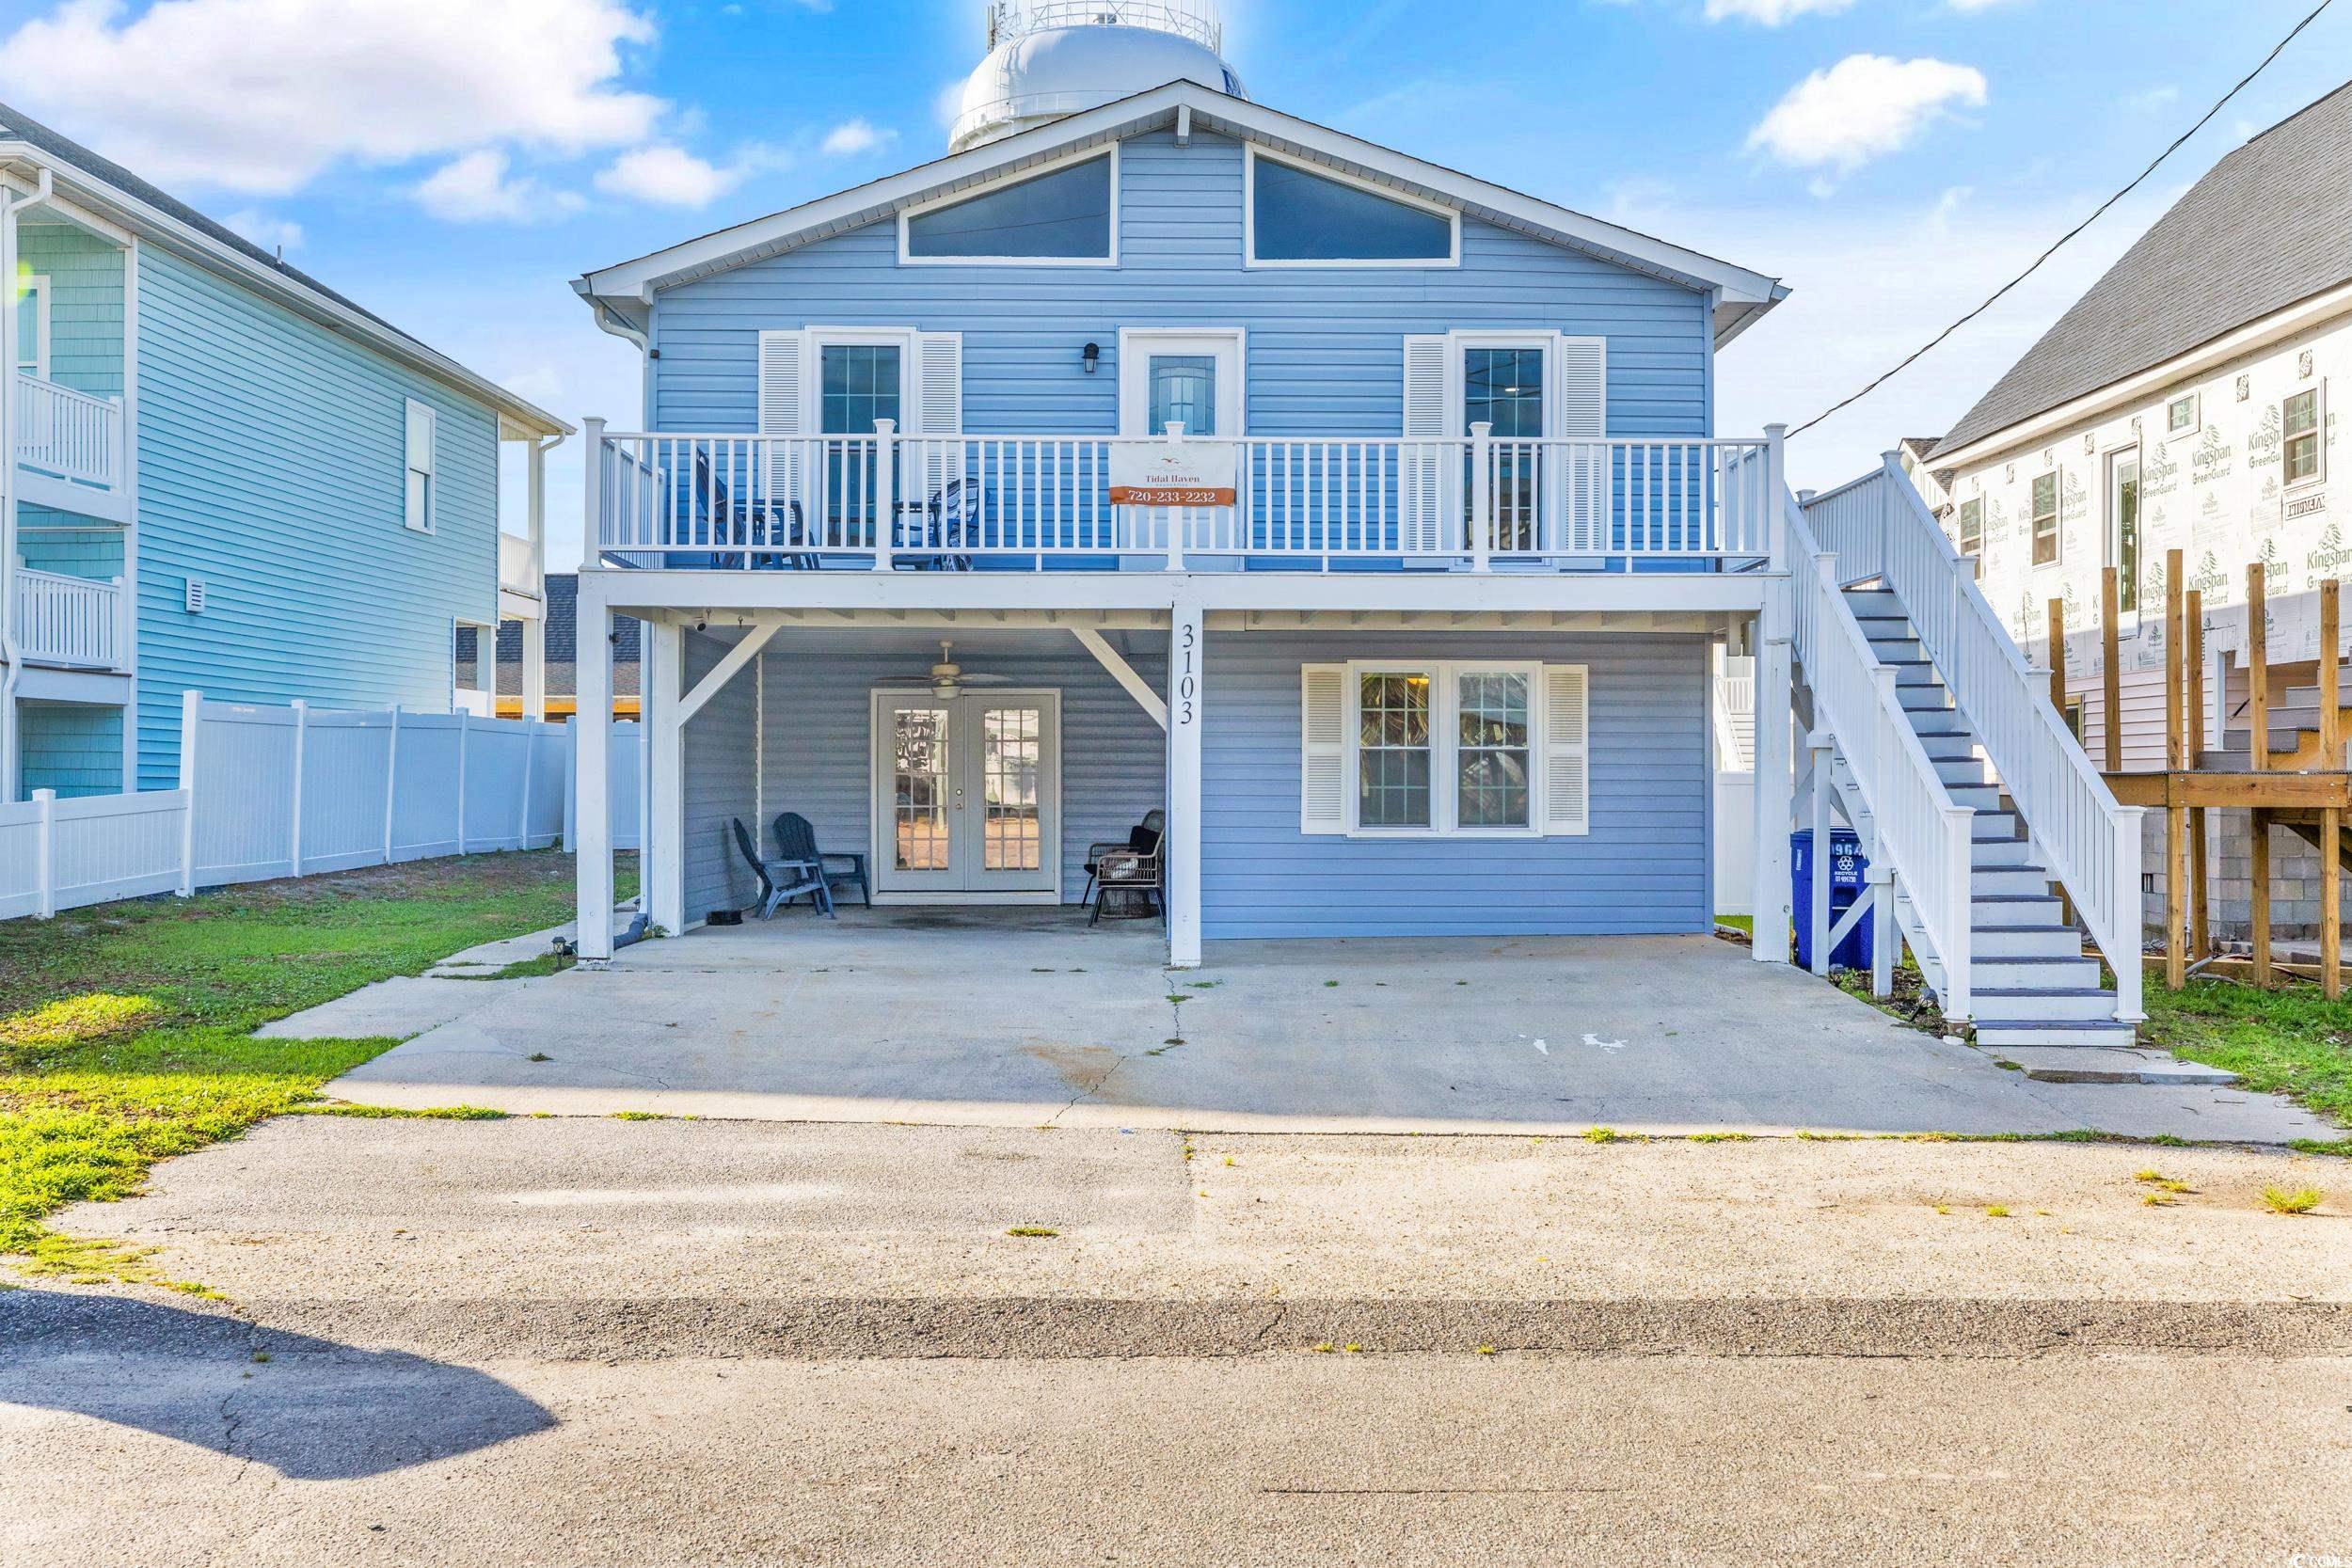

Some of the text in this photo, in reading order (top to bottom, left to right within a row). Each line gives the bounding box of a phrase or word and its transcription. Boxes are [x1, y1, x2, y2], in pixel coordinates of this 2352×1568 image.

[2249, 431, 2281, 451] Kingsp
[2192, 445, 2231, 469] Kingspan
[2143, 462, 2177, 484] Kingspan
[2192, 466, 2231, 485] GreenGuard
[1128, 490, 1216, 503] 720-233-2232
[2188, 573, 2228, 594] Kingspan
[1181, 624, 1195, 725] 3103
